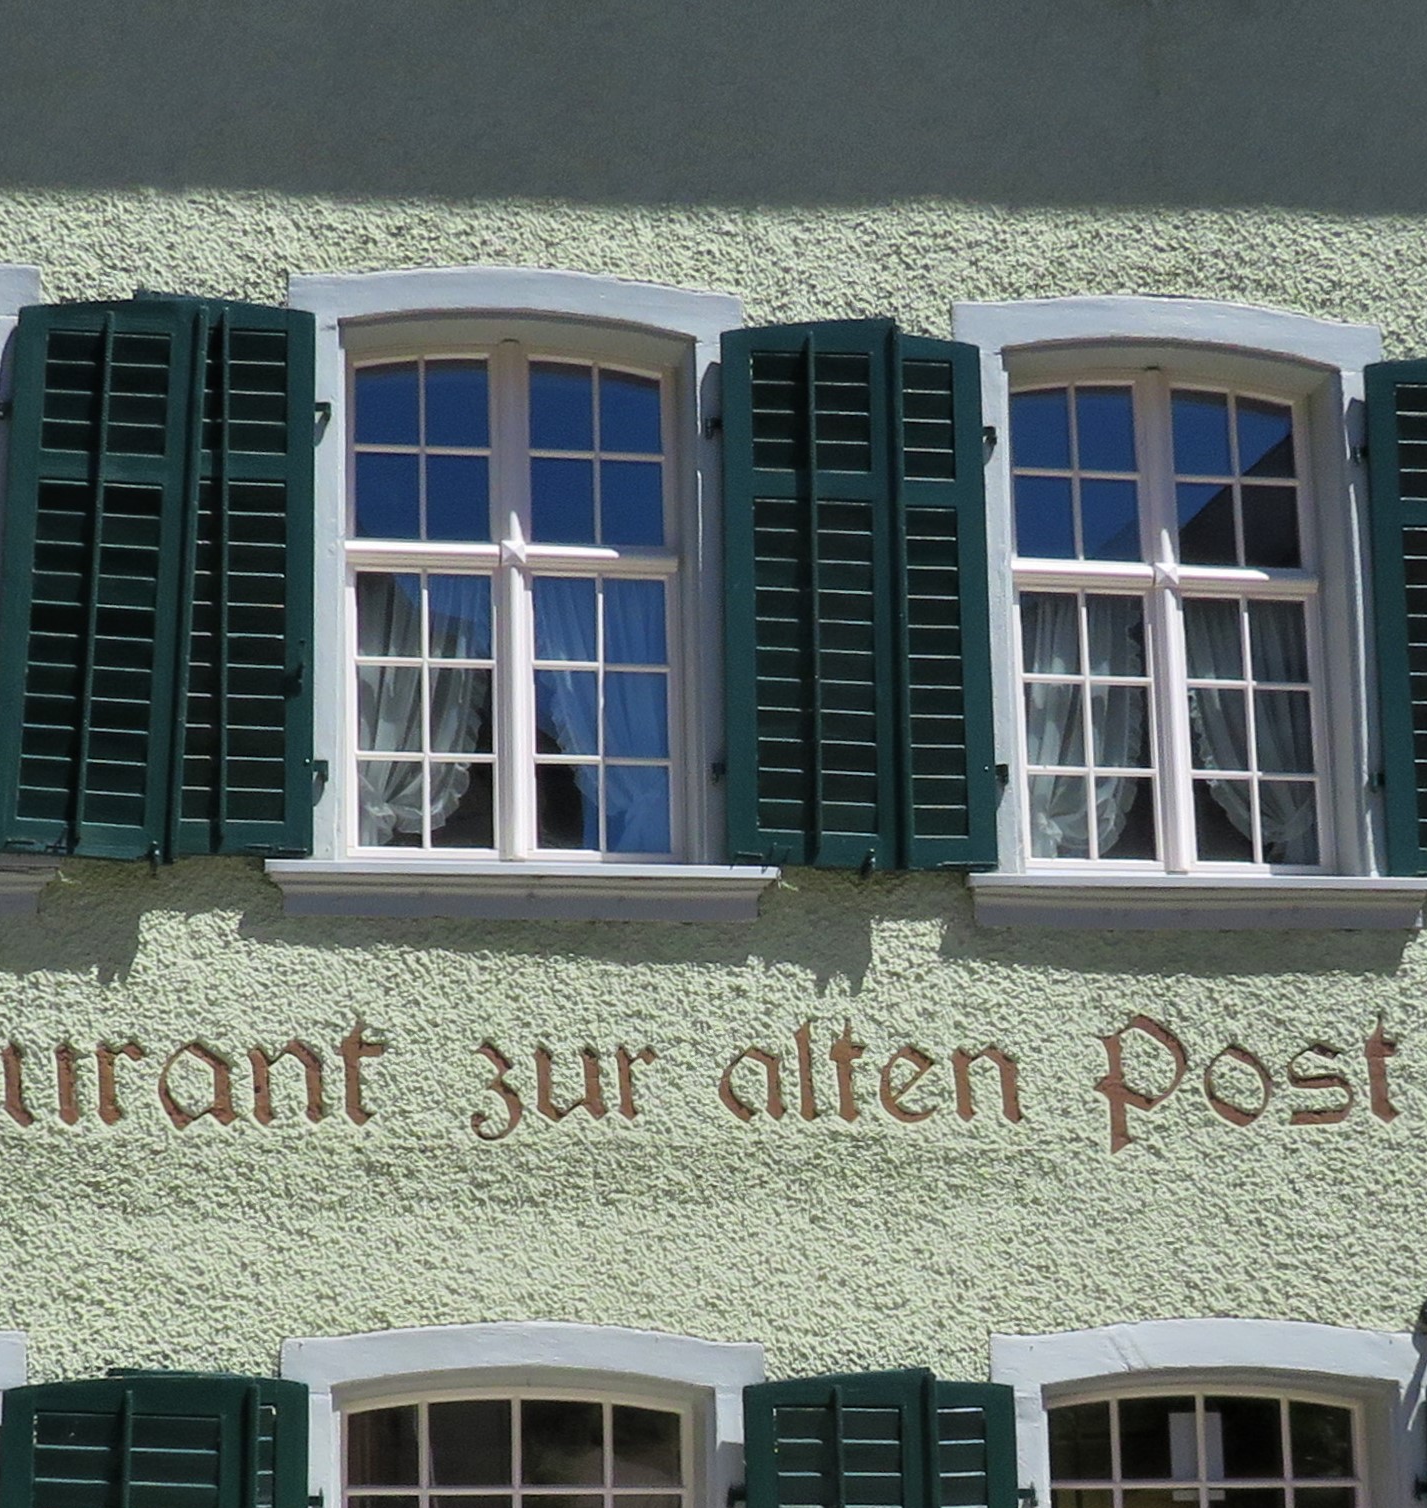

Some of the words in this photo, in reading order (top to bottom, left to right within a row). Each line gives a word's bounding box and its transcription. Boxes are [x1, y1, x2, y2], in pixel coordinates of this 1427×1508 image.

[471, 1041, 656, 1139] zur
[719, 1017, 1022, 1123] alten
[1094, 1013, 1399, 1153] Post
